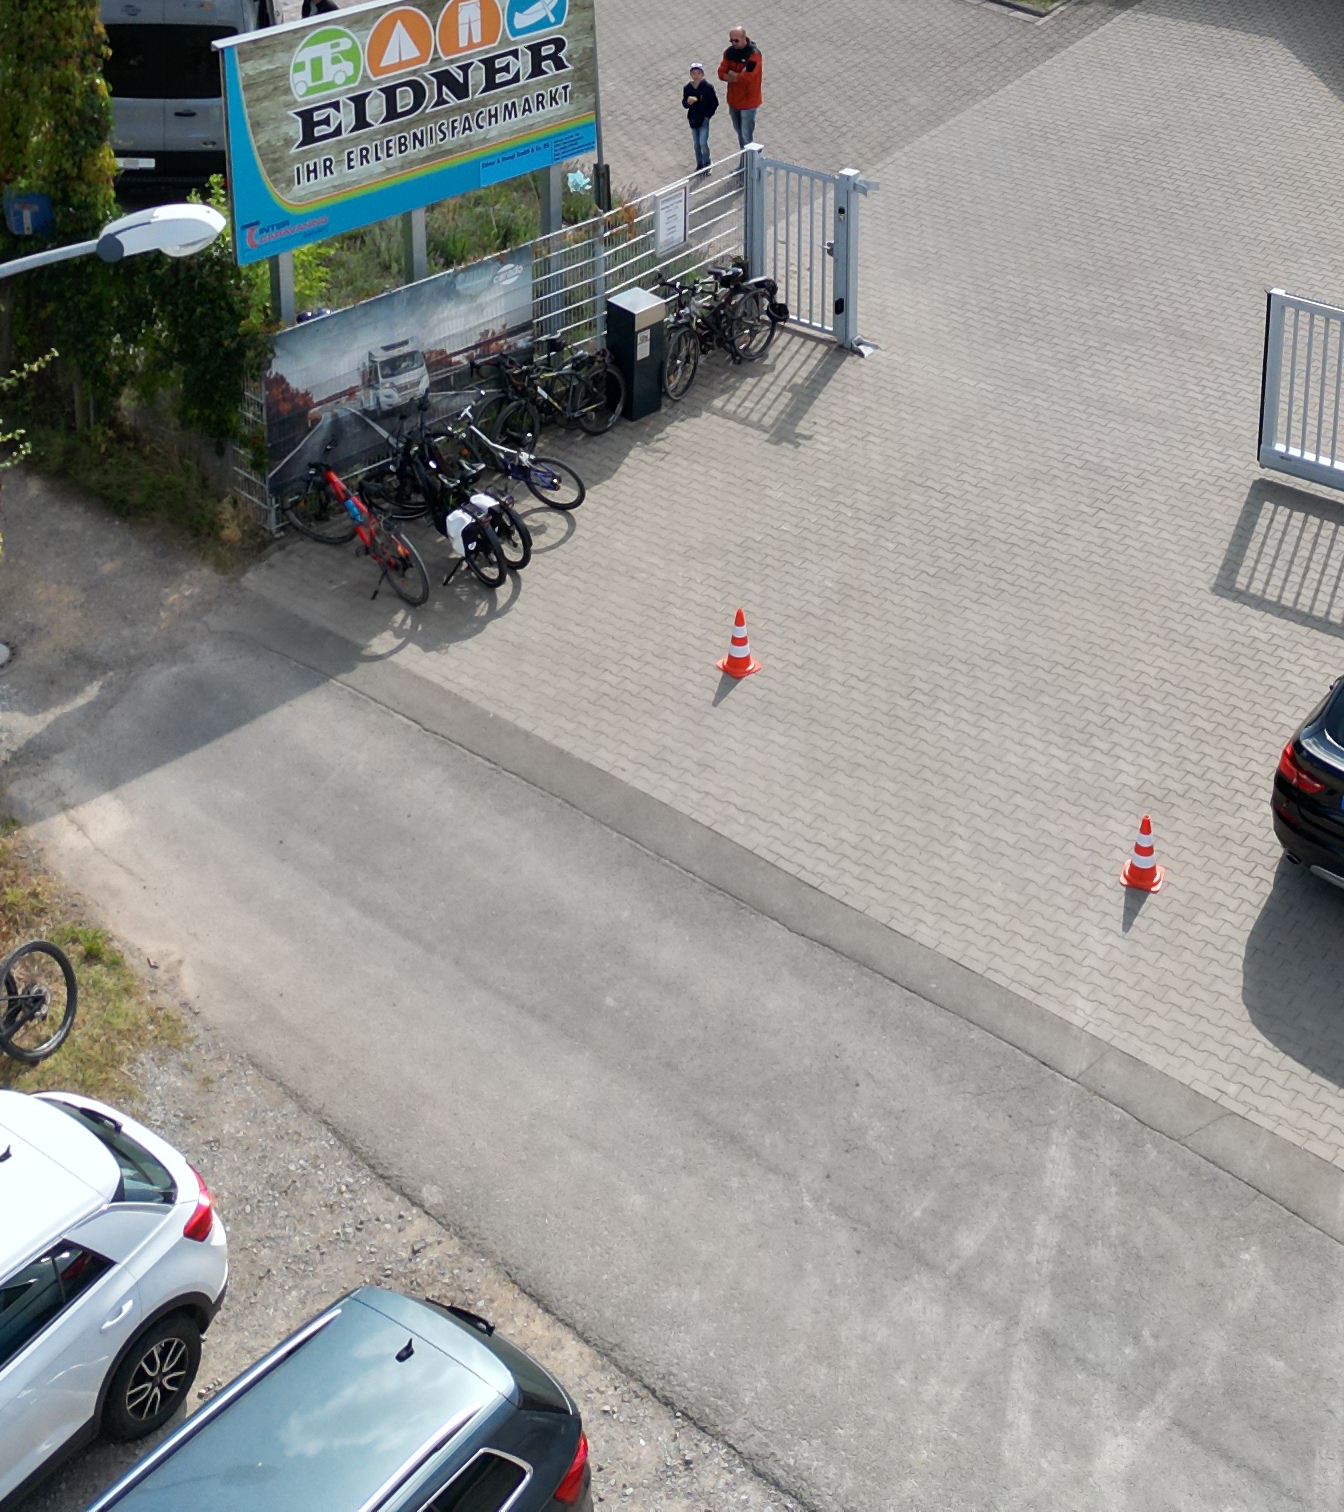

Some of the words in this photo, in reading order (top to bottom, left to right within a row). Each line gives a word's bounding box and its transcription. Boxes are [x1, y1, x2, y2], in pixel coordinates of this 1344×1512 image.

[288, 34, 574, 153] EIDNER
[294, 157, 335, 187] IHR
[346, 83, 572, 173] ERLEBNISFACHMARKT
[258, 220, 290, 235] INTER
